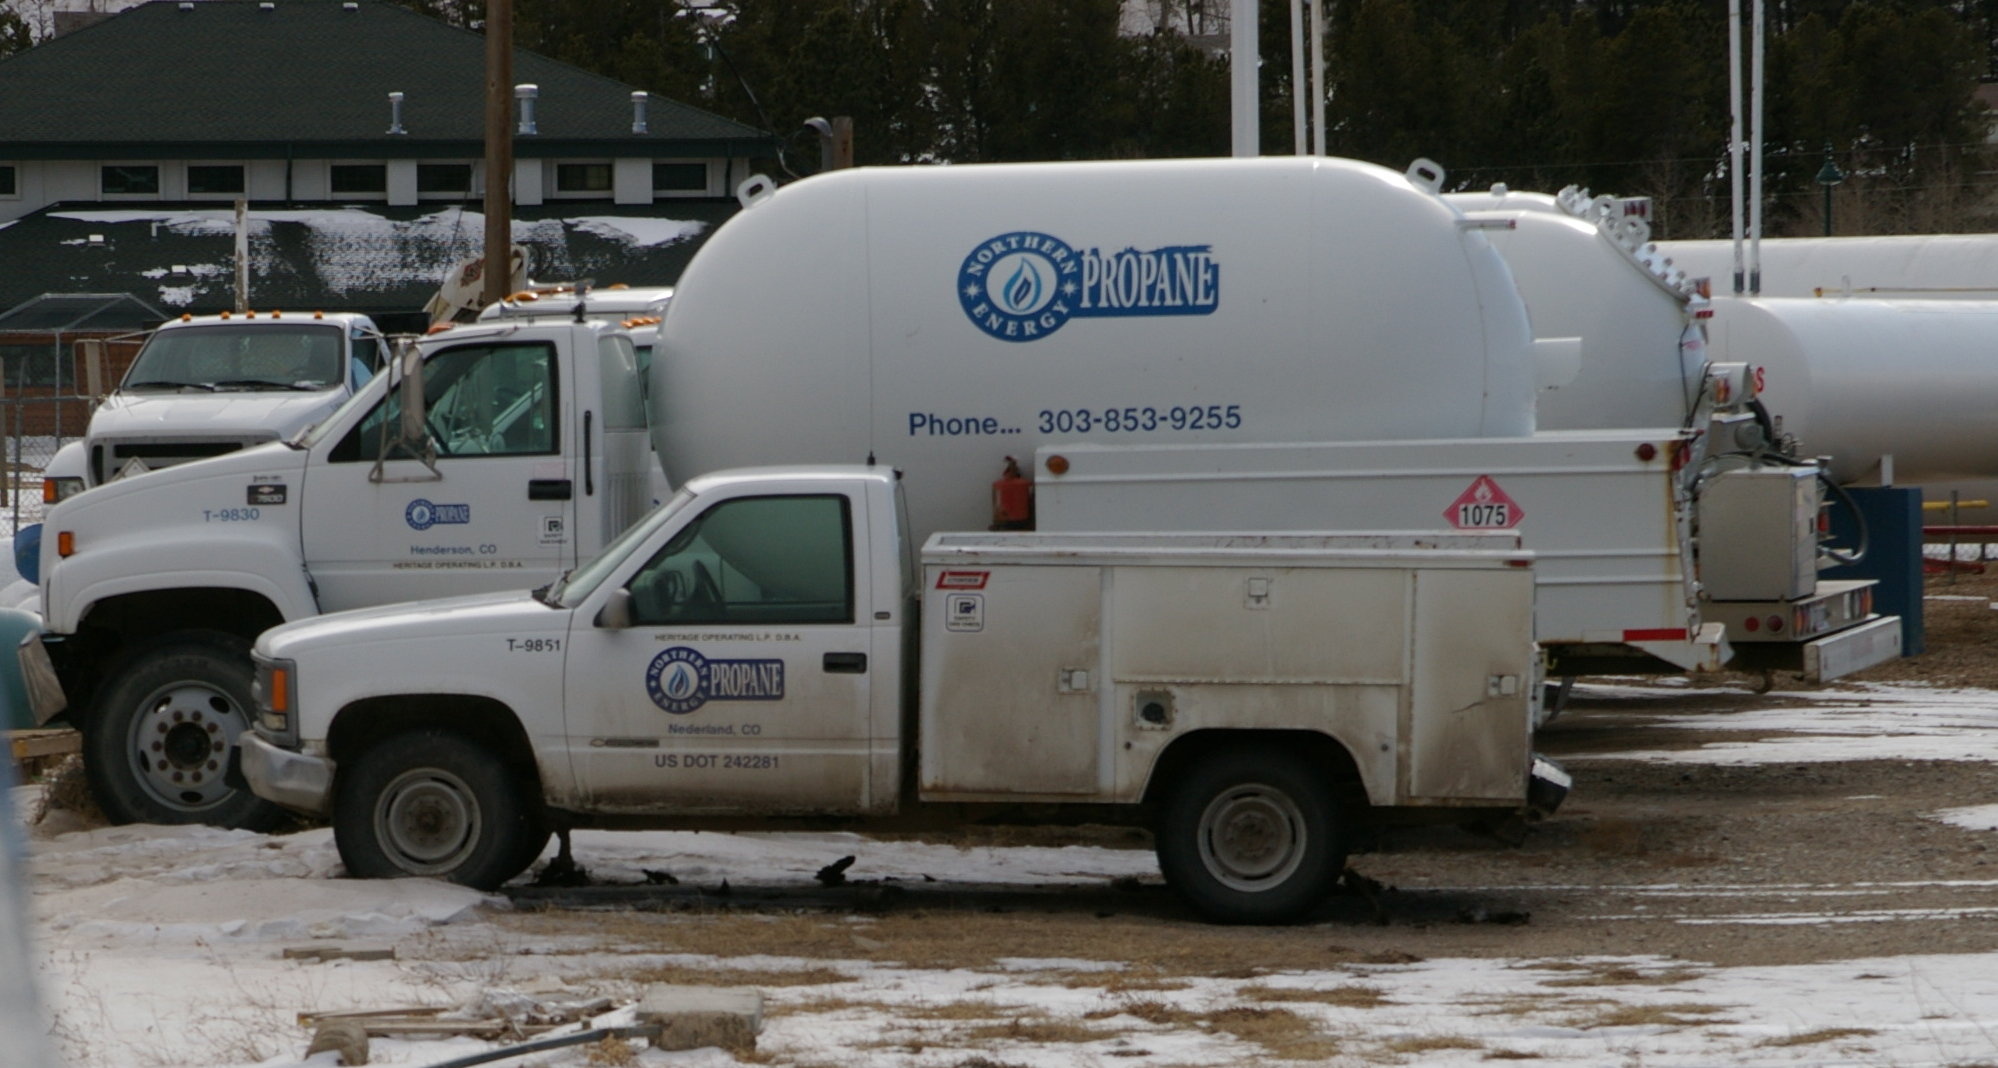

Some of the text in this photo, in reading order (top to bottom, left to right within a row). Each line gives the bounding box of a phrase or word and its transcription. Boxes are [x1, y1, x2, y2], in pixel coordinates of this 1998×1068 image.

[966, 235, 1078, 277] NORTHERN
[1080, 250, 1215, 309] PROPANE
[972, 300, 1070, 336] ENERGY
[909, 405, 1242, 437] Phone... 303-853-9255
[203, 508, 260, 522] T-9830
[1461, 505, 1506, 526] 1075
[410, 544, 497, 555] Henderson, CO
[393, 561, 433, 569] HERITAGE
[435, 561, 482, 569] OPERATING
[506, 639, 561, 652] T-9851
[655, 634, 700, 642] HERITAGE
[702, 634, 754, 642] OPERATING
[650, 650, 709, 677] NORTHERN
[710, 663, 782, 697] PROPANE
[653, 691, 706, 711] ENERGY
[668, 723, 761, 736] Nederland, CO
[655, 755, 779, 769] US DOT 242281
